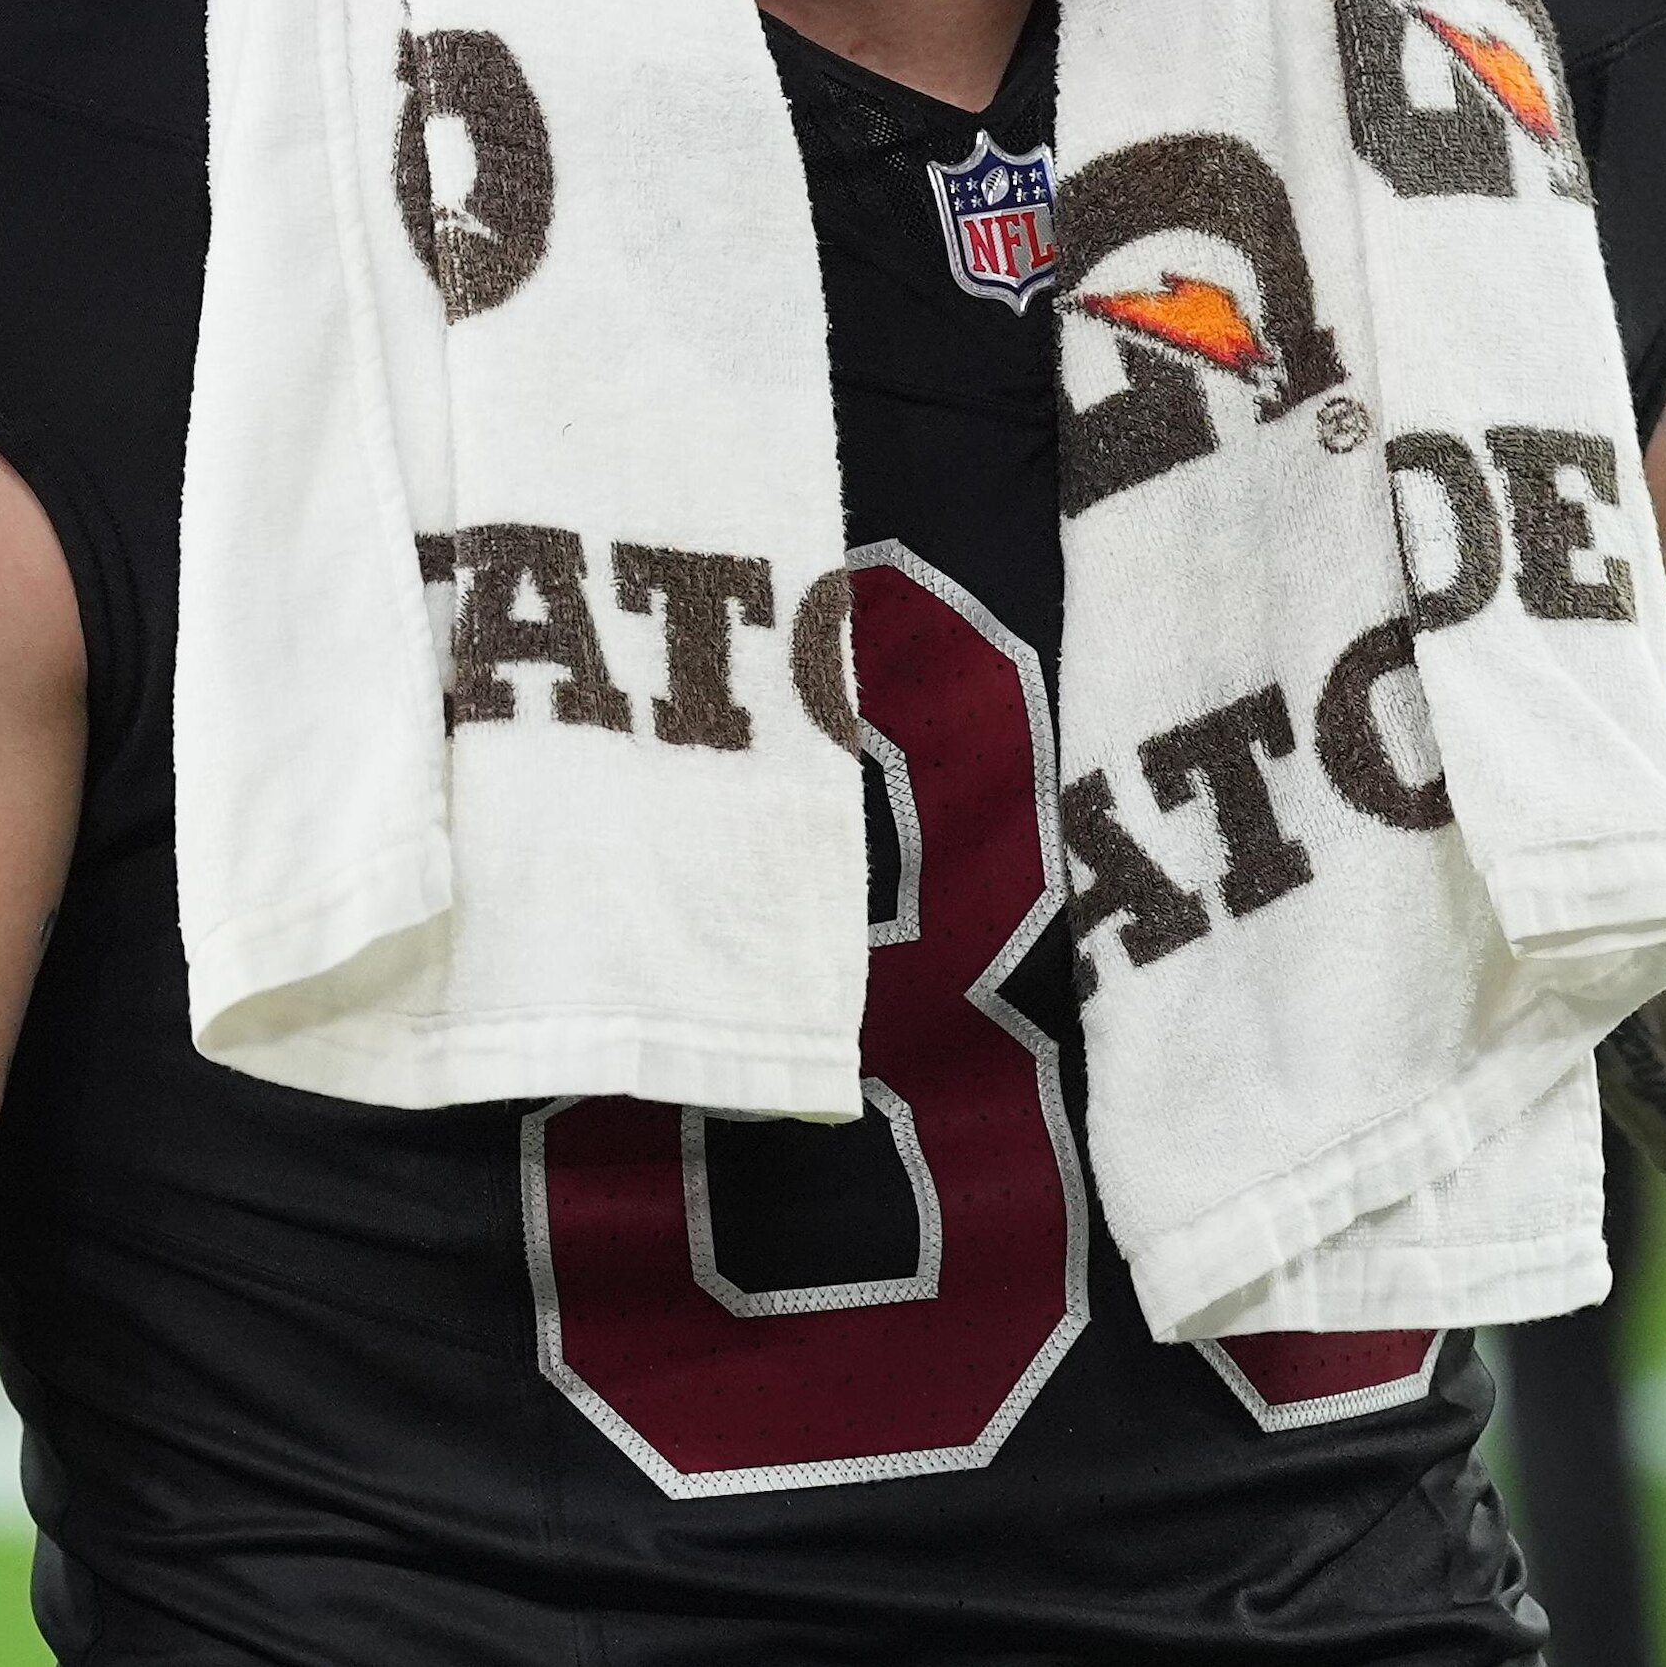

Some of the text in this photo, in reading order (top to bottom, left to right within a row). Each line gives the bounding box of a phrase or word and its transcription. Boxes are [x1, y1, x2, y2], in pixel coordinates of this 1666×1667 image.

[964, 210, 1055, 279] NFL
[1384, 424, 1637, 633] DE
[522, 539, 1449, 1500] 8
